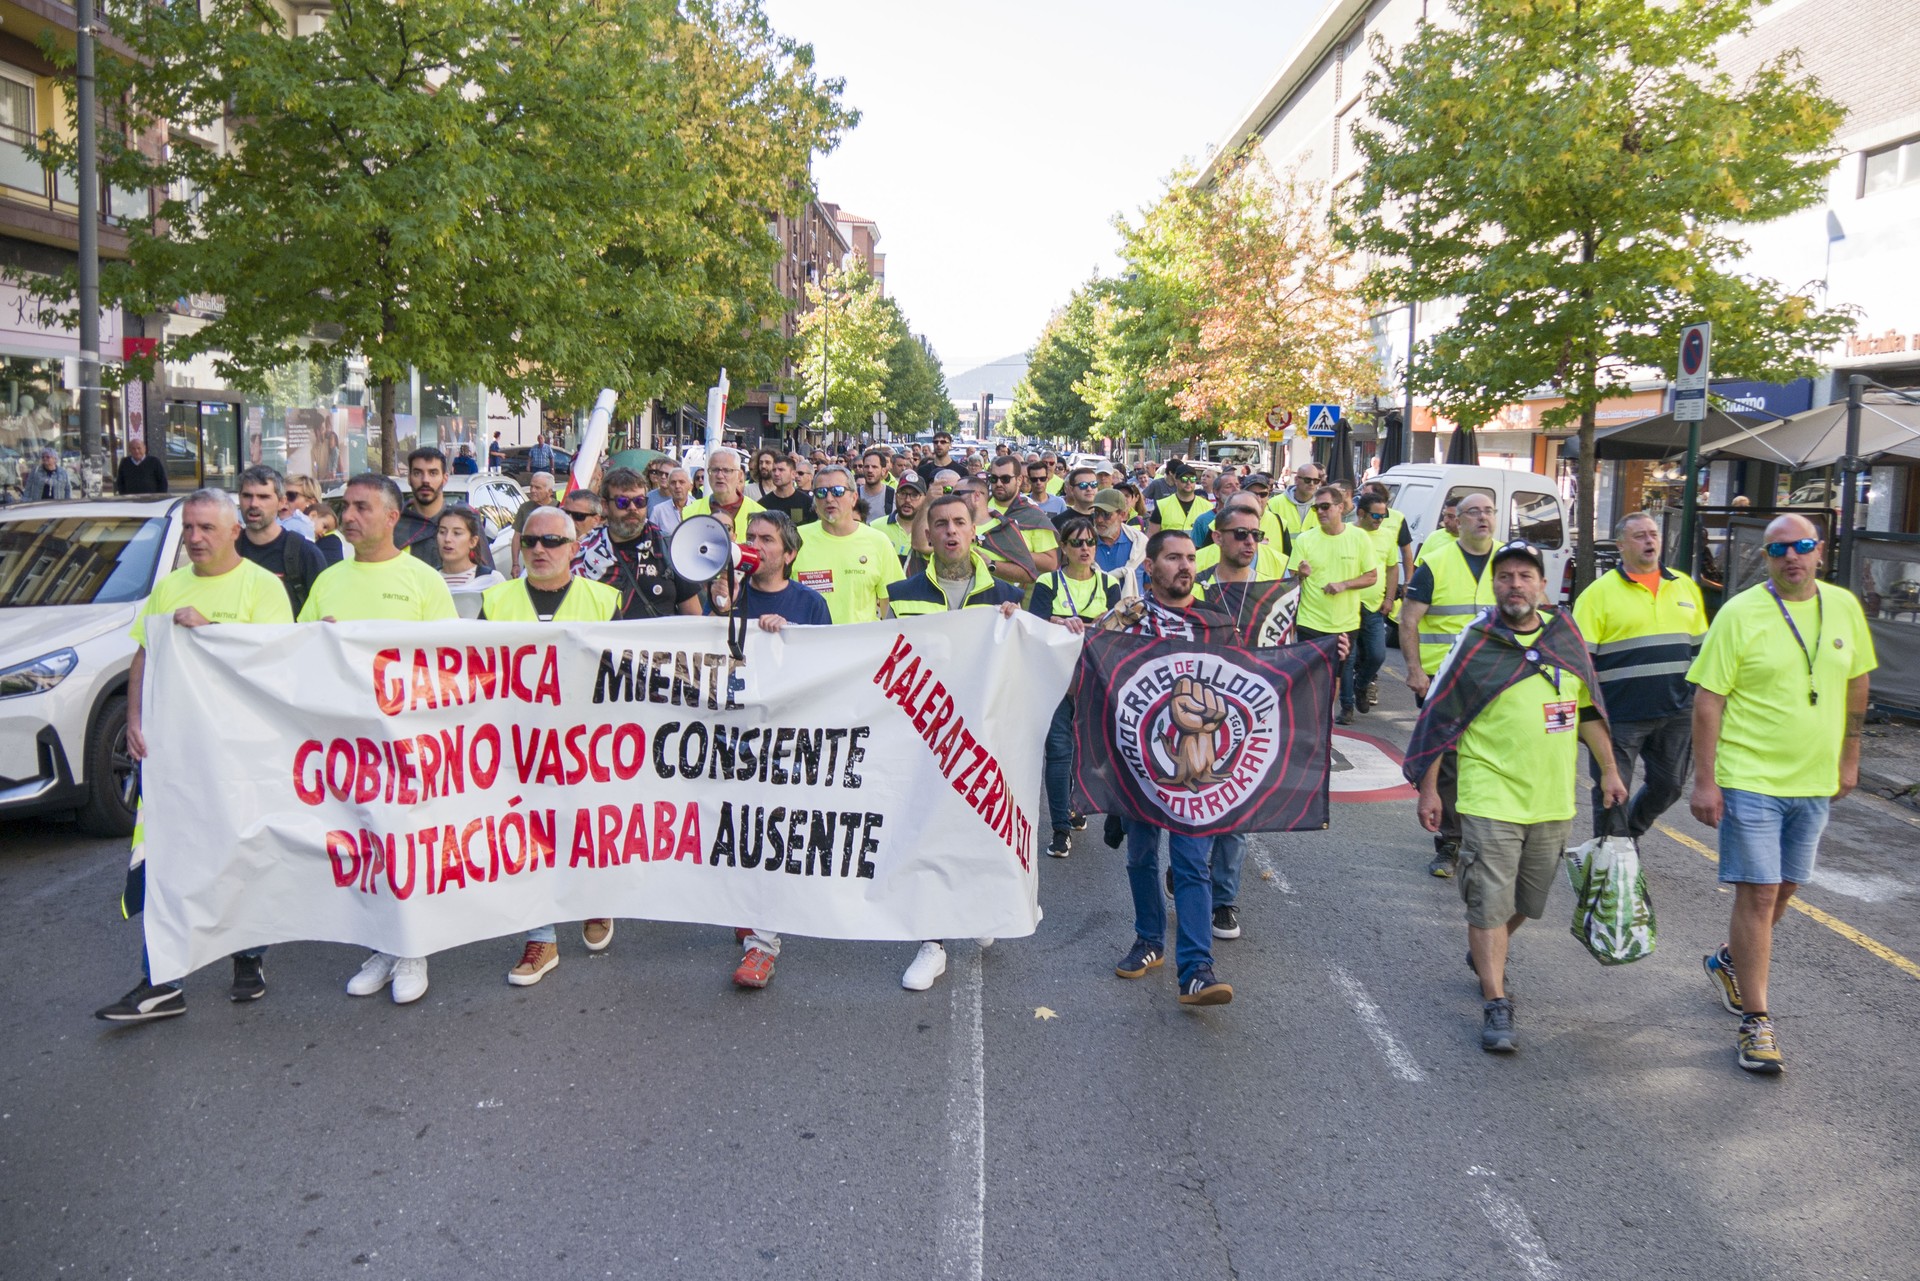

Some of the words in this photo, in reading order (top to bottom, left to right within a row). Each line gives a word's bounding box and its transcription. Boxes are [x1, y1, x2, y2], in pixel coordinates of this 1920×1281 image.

[211, 610, 238, 620] garnica
[382, 592, 410, 602] garnica
[373, 644, 562, 717] GARNICA
[592, 648, 746, 711] MIENTE
[1119, 665, 1175, 781] MADERAS
[1174, 660, 1195, 675] DE
[293, 722, 500, 806] GOBIERNO
[511, 722, 646, 786] VASCO
[652, 721, 870, 789] CONSIENTE
[873, 633, 1014, 847] KALERATZERIK
[326, 795, 556, 900] DIPUTACIÓN
[568, 801, 702, 869] ARABA
[709, 801, 884, 879] AUSENTE
